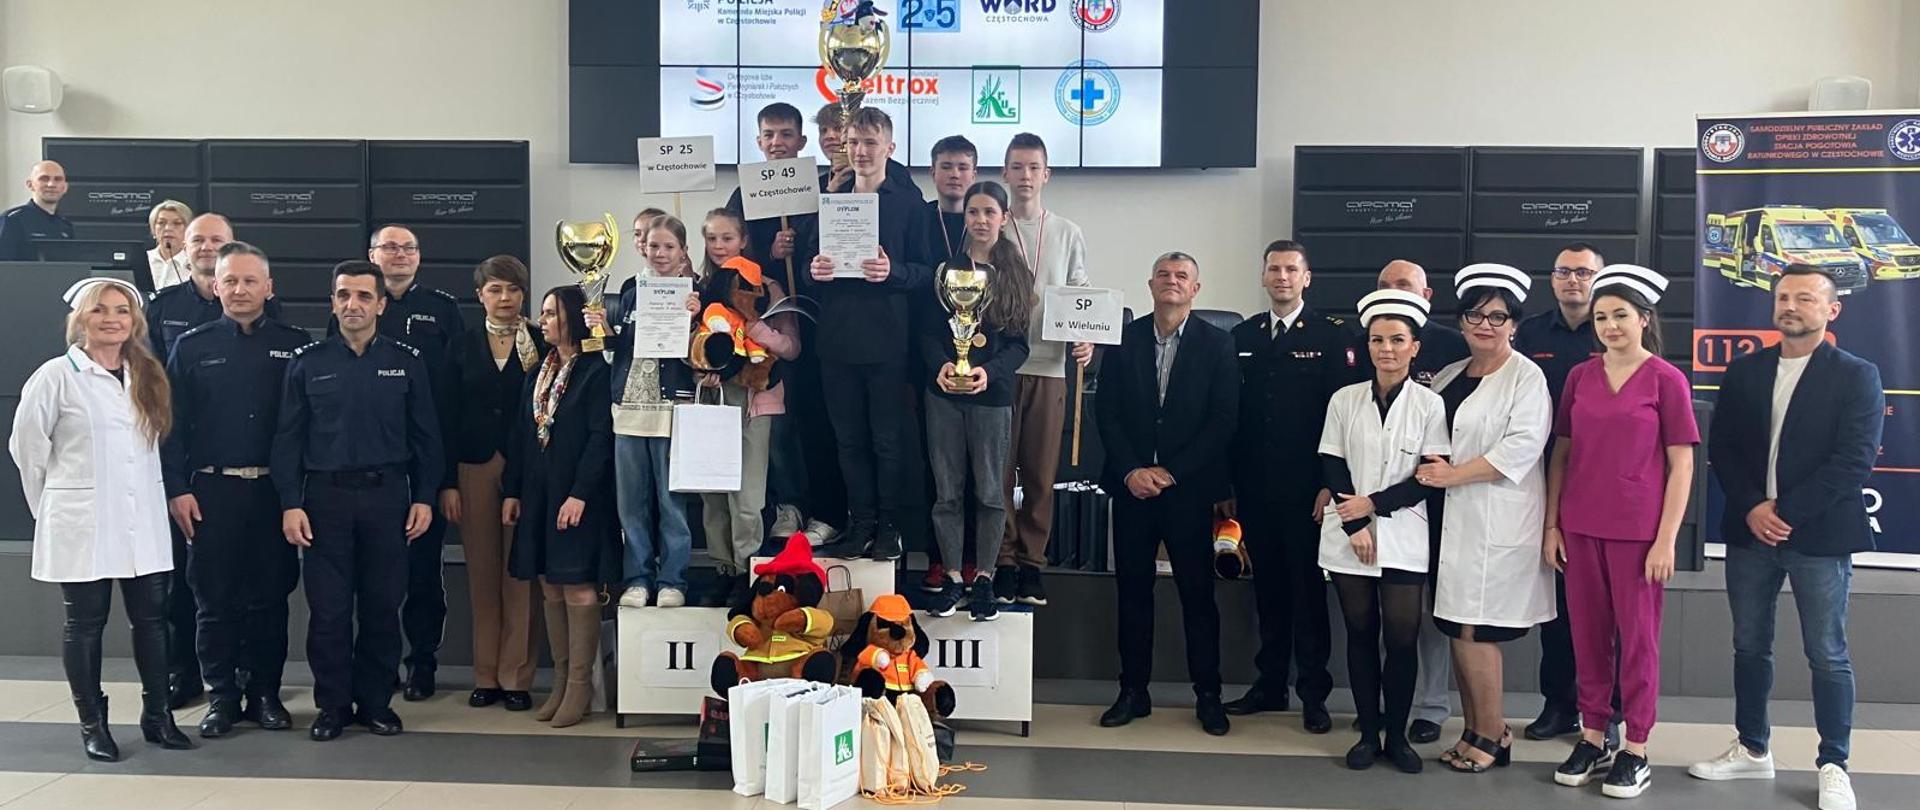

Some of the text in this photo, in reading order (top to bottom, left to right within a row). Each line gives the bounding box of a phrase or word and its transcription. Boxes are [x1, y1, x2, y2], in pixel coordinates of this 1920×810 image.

[660, 144, 693, 155] SP 25
[656, 163, 707, 171] Częstochowie
[761, 167, 796, 181] SP 49
[758, 185, 812, 198] Częstochowie
[1075, 298, 1092, 310] SP
[1068, 320, 1111, 331] Wieluniu
[665, 640, 697, 670] II
[935, 638, 983, 668] III
